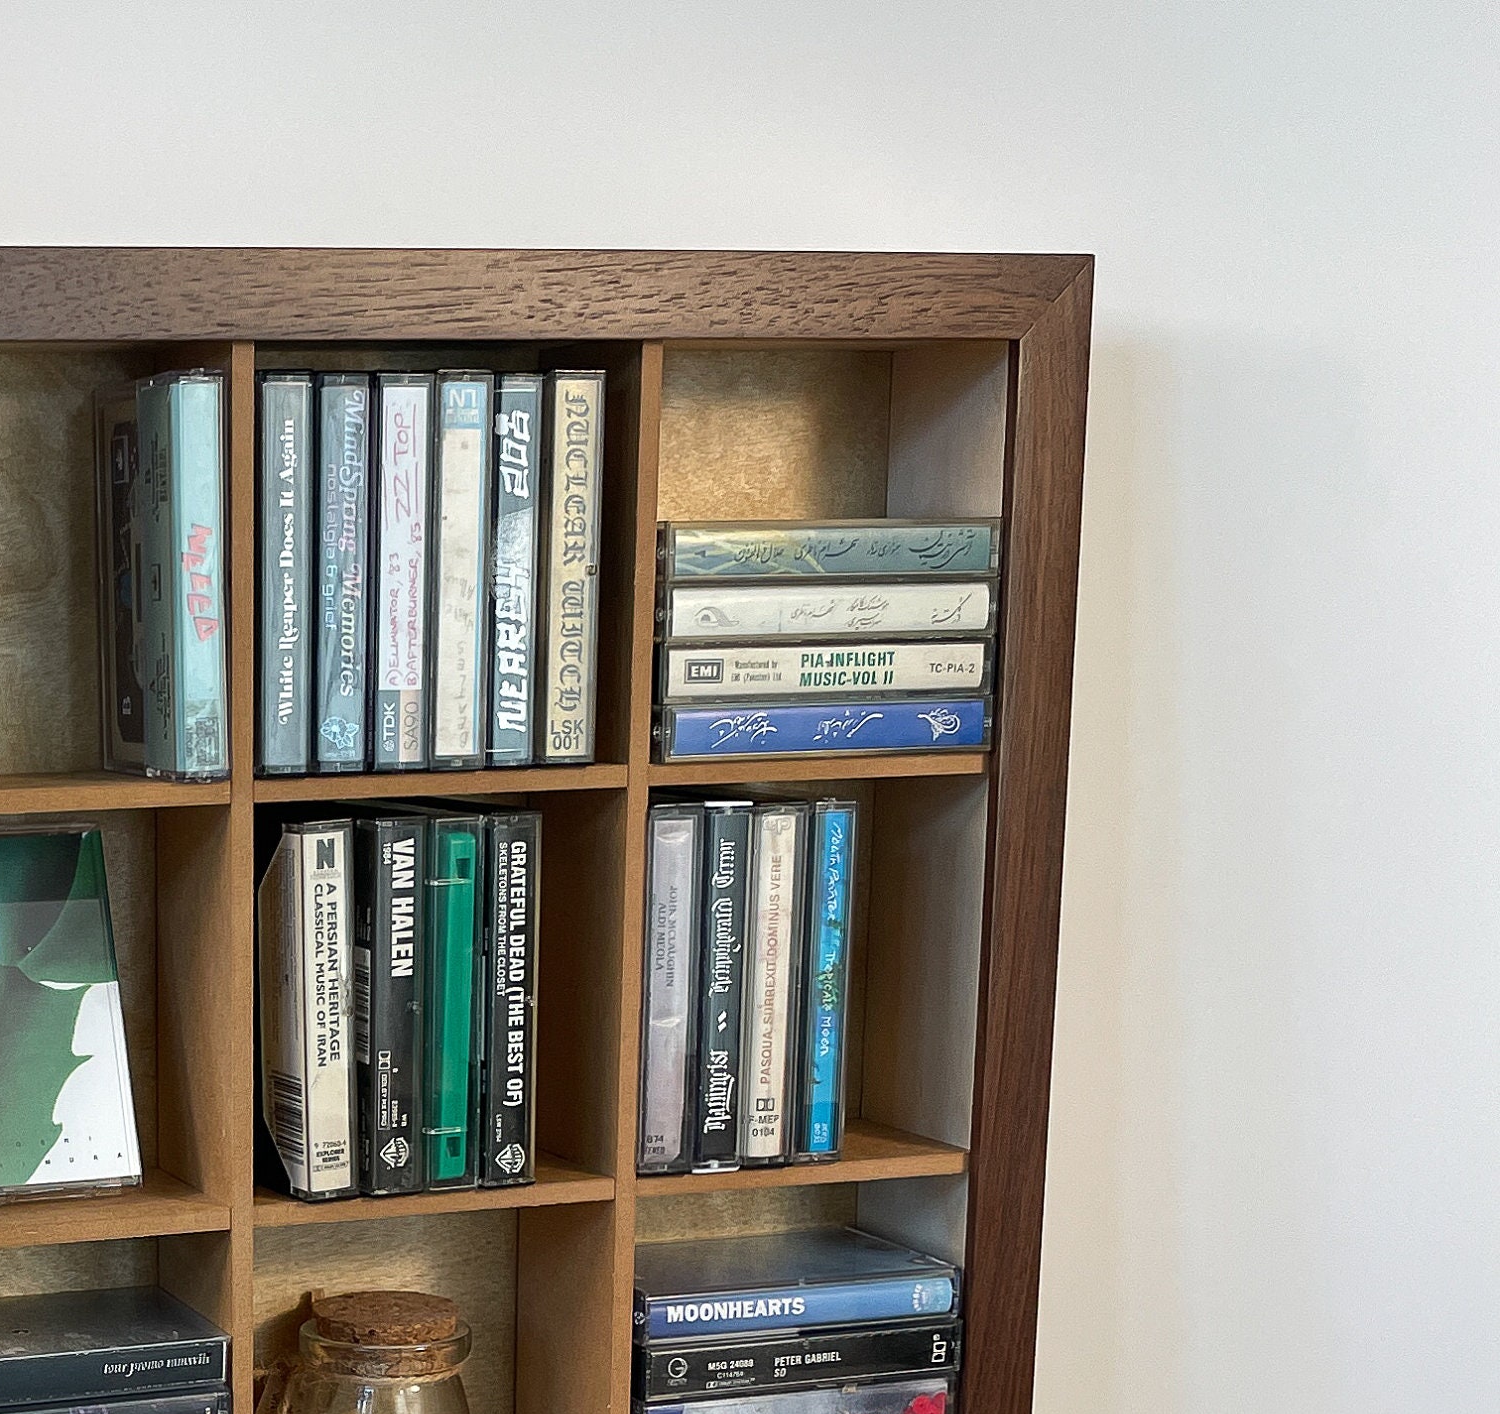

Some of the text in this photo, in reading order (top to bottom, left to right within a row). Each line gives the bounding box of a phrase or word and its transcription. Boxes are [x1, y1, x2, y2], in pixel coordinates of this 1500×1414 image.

[279, 418, 299, 724] White Reaper Does It Again
[690, 664, 719, 678] EMI
[801, 651, 895, 668] PIA-INFLIGHT
[929, 663, 976, 674] TC-PIA-2
[800, 671, 894, 687] MUSIC-VOL II
[384, 703, 395, 741] TDK
[404, 701, 419, 750] SA90
[551, 719, 584, 736] LSK
[553, 736, 579, 750] 001
[326, 883, 336, 897] A
[391, 838, 415, 978] VAN HALEN
[494, 842, 508, 998] SKELETONS FROM THE CLOSET
[326, 902, 339, 973] PERSIAN
[312, 884, 327, 1068] CLASSICAL MUSIC OF IRAN
[502, 841, 527, 1108] GRATEFUL DEAD (THE BEST OF)
[328, 977, 341, 1062] HERITAGE
[666, 1298, 805, 1323] MOONHEARTS
[774, 1352, 841, 1367] PETER GABRIEL
